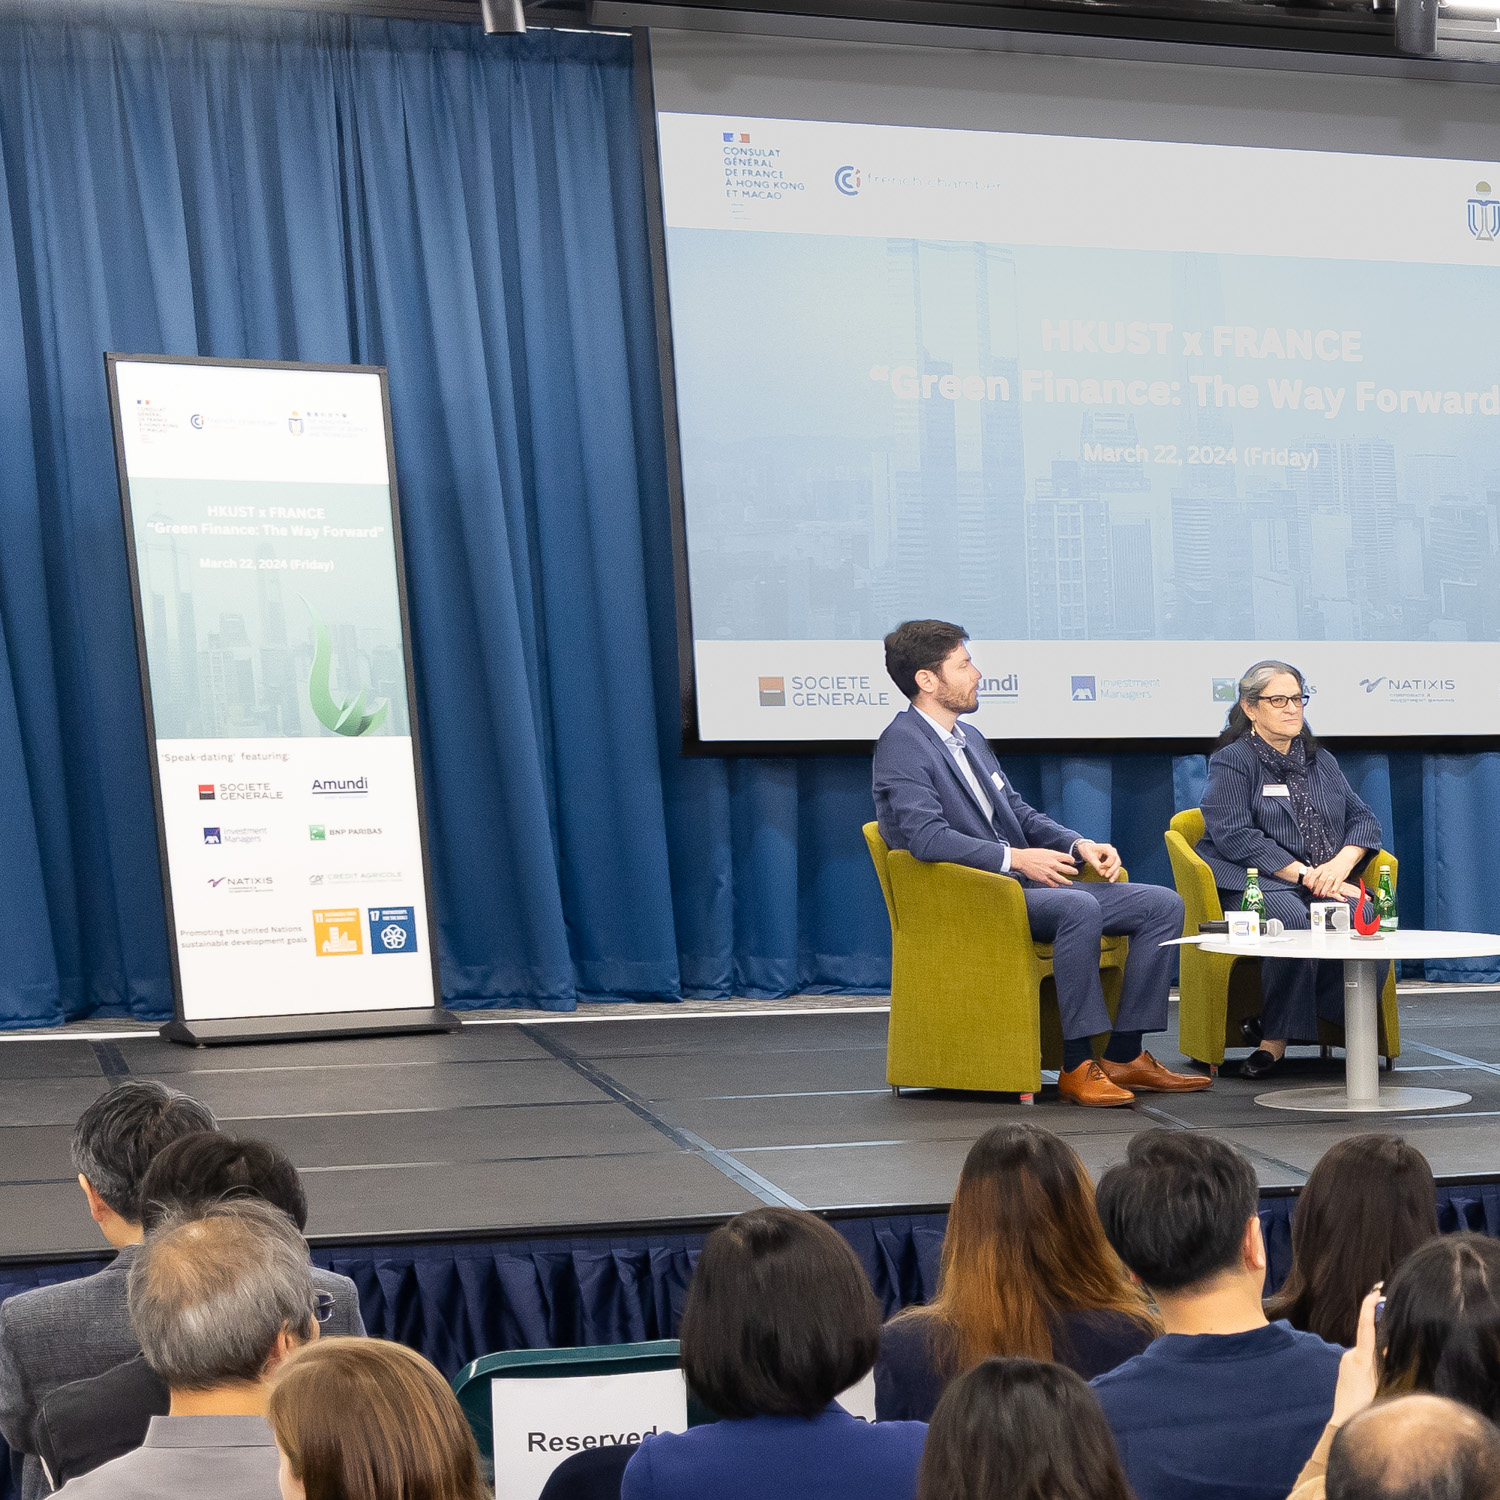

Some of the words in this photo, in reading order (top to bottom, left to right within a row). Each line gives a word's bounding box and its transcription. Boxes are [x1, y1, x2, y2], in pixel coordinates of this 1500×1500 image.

[723, 147, 781, 158] CONSULAT
[724, 157, 773, 168] GÉNÉRAL
[725, 168, 739, 177] DE
[742, 169, 783, 179] FRANCE
[736, 179, 769, 189] HONG
[773, 181, 805, 191] KONG
[726, 189, 738, 198] ET
[742, 189, 782, 200] MACAO
[1040, 319, 1173, 355] HKUST
[1212, 328, 1364, 362] FRANCE
[1021, 371, 1183, 406] Finance:
[1189, 375, 1260, 408] The
[1266, 378, 1350, 419] Way
[1083, 443, 1149, 464] March
[1153, 446, 1184, 467] 22,
[1187, 446, 1239, 466] 2024
[1243, 447, 1320, 470] (Friday)
[208, 505, 255, 517] HKUST
[269, 507, 326, 520] FRANCE
[201, 523, 260, 536] Finance:
[262, 525, 289, 536] The
[291, 526, 320, 539] Way
[200, 558, 237, 569] March
[239, 559, 257, 570] 22,
[259, 559, 288, 569] 2024
[290, 559, 335, 571] (Friday)
[792, 676, 870, 690] SOCIETE
[977, 674, 1019, 692] undi
[1388, 679, 1456, 690] NATIXIS
[793, 692, 890, 706] GENERALE
[220, 783, 271, 791] SOCIETE
[312, 776, 368, 790] Amundi
[220, 791, 284, 800] GENERALE
[227, 877, 273, 886] NATIXIS
